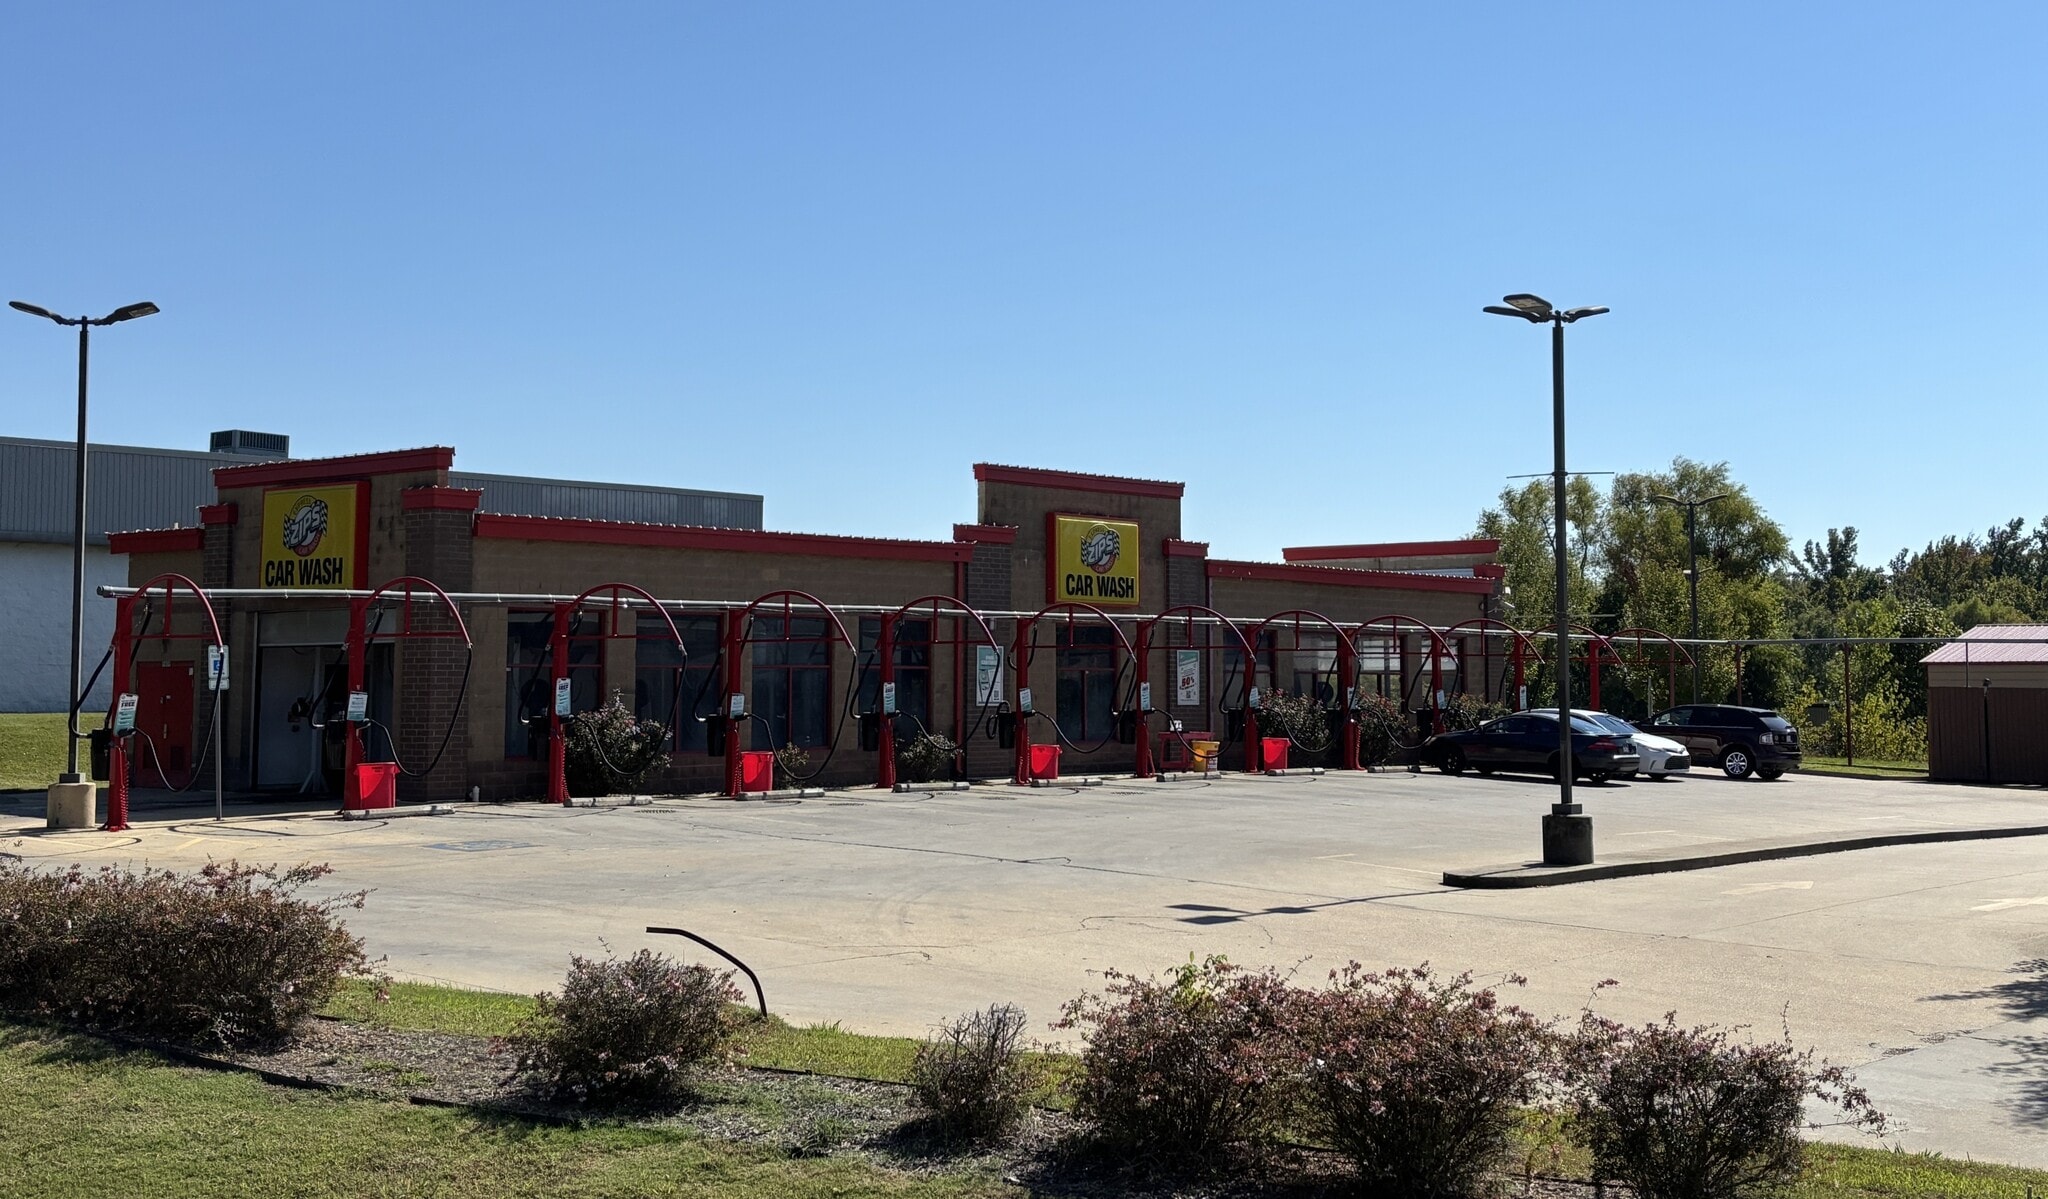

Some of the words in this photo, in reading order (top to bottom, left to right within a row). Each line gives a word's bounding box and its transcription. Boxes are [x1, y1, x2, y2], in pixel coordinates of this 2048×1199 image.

[290, 505, 321, 545] ZIPS
[1087, 534, 1114, 563] ZIPS
[265, 560, 295, 587] CAR
[298, 557, 343, 585] WASH
[1066, 573, 1093, 596] CAR
[1096, 575, 1135, 598] WASH
